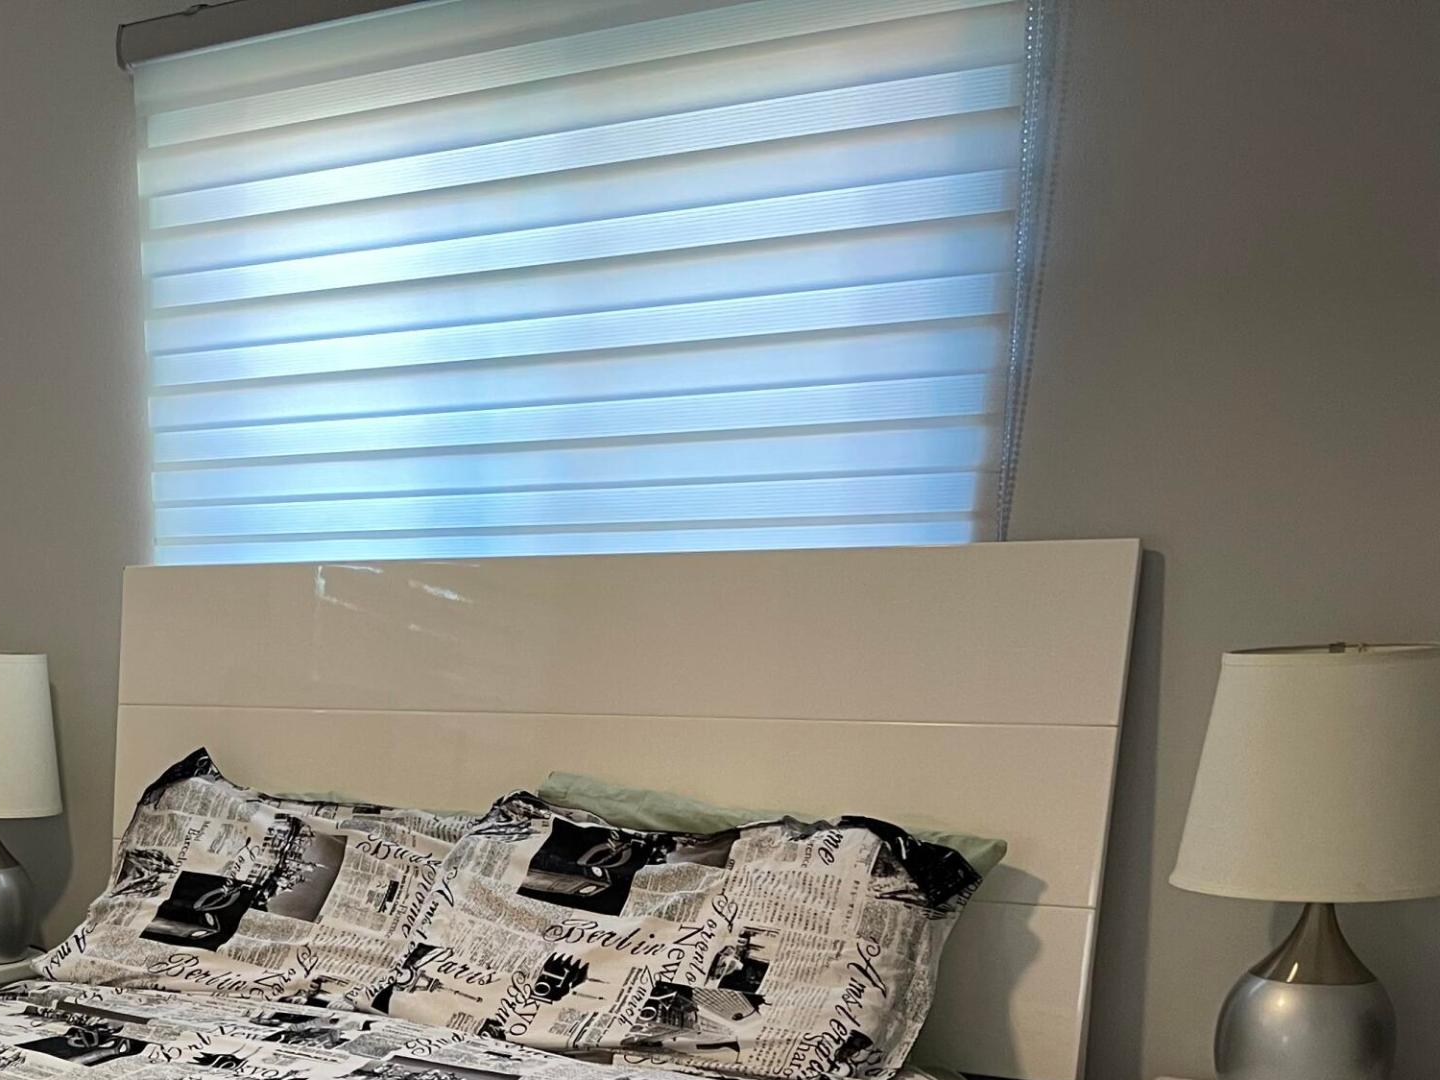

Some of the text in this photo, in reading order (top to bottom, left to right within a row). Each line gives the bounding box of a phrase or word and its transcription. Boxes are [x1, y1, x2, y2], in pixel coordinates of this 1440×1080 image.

[543, 918, 666, 956] Berlin
[148, 952, 246, 992] Berlin
[414, 944, 501, 987] Paris
[508, 967, 571, 1037] Tokyo
[208, 1054, 280, 1079] Tokyo
